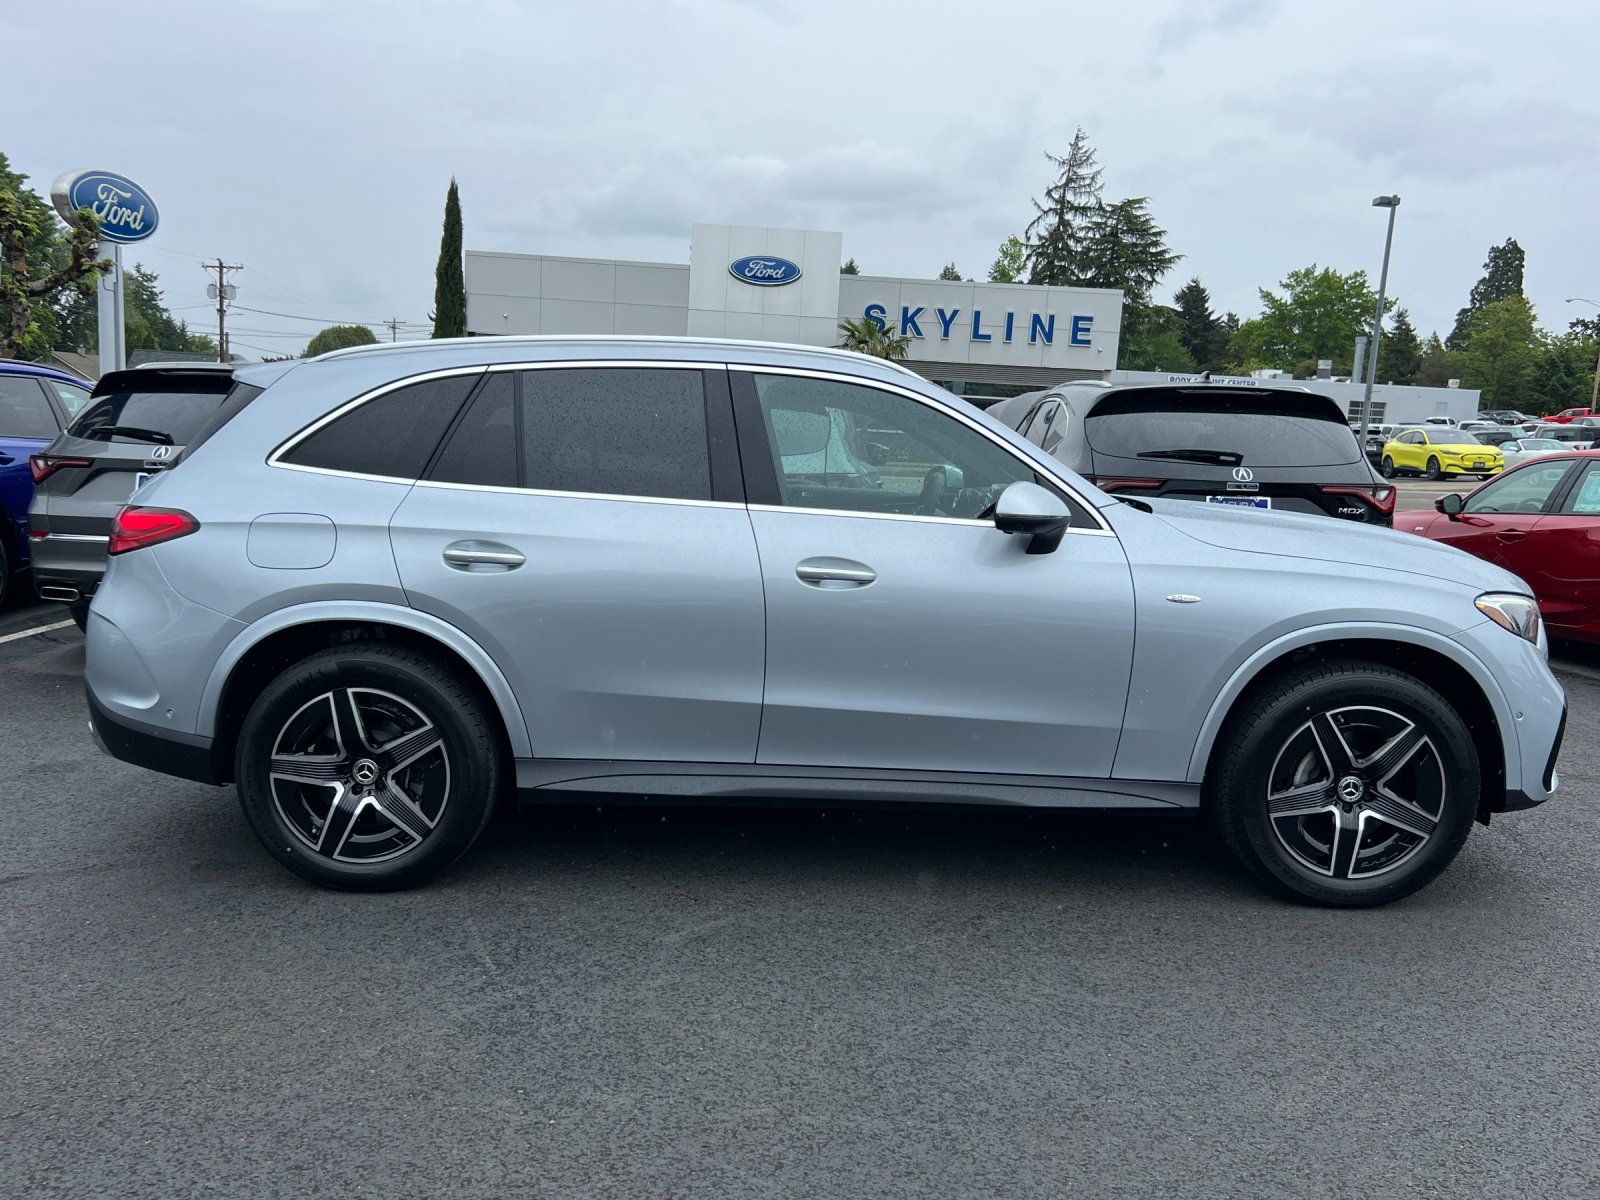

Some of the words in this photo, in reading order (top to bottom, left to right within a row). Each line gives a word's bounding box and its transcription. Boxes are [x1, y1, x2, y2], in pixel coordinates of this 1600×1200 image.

[92, 183, 144, 231] Ford
[744, 260, 786, 279] Ford
[863, 303, 1094, 347] SKYLINE
